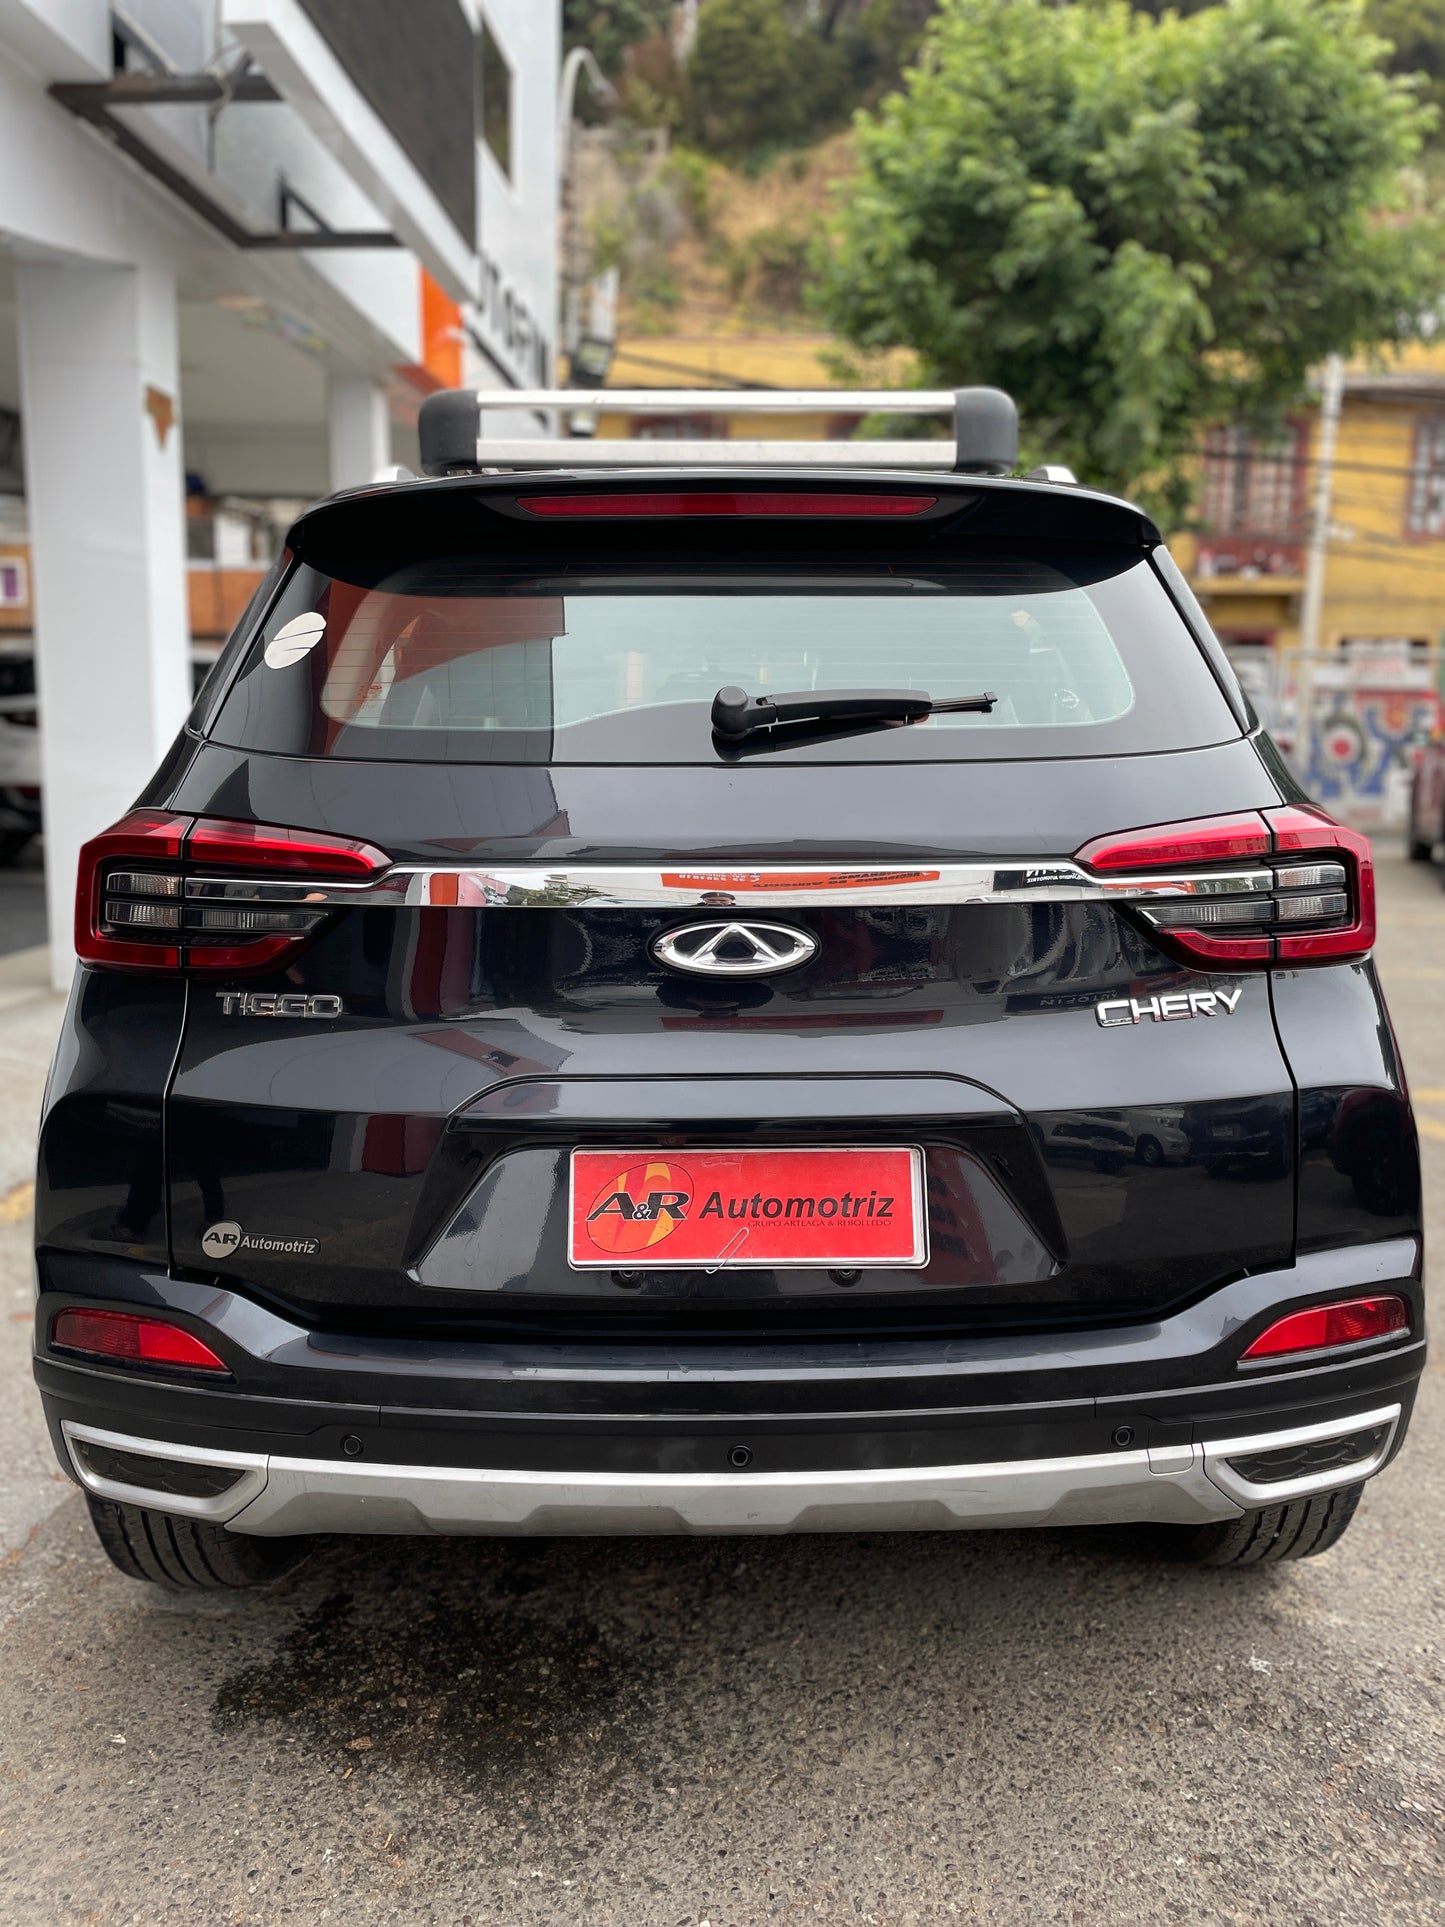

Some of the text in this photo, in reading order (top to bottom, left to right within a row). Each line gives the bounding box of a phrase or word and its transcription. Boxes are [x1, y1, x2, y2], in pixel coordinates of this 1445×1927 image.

[215, 991, 343, 1018] TIGGO
[1096, 989, 1243, 1027] CHERY
[586, 1191, 690, 1221] A&R
[698, 1190, 895, 1219] Automotriz
[747, 1219, 782, 1227] GRUPO
[783, 1219, 825, 1227] ARTEAGA
[837, 1219, 892, 1227] REBOLLEDO
[204, 1231, 239, 1245] AR
[240, 1235, 316, 1254] Automotriz
